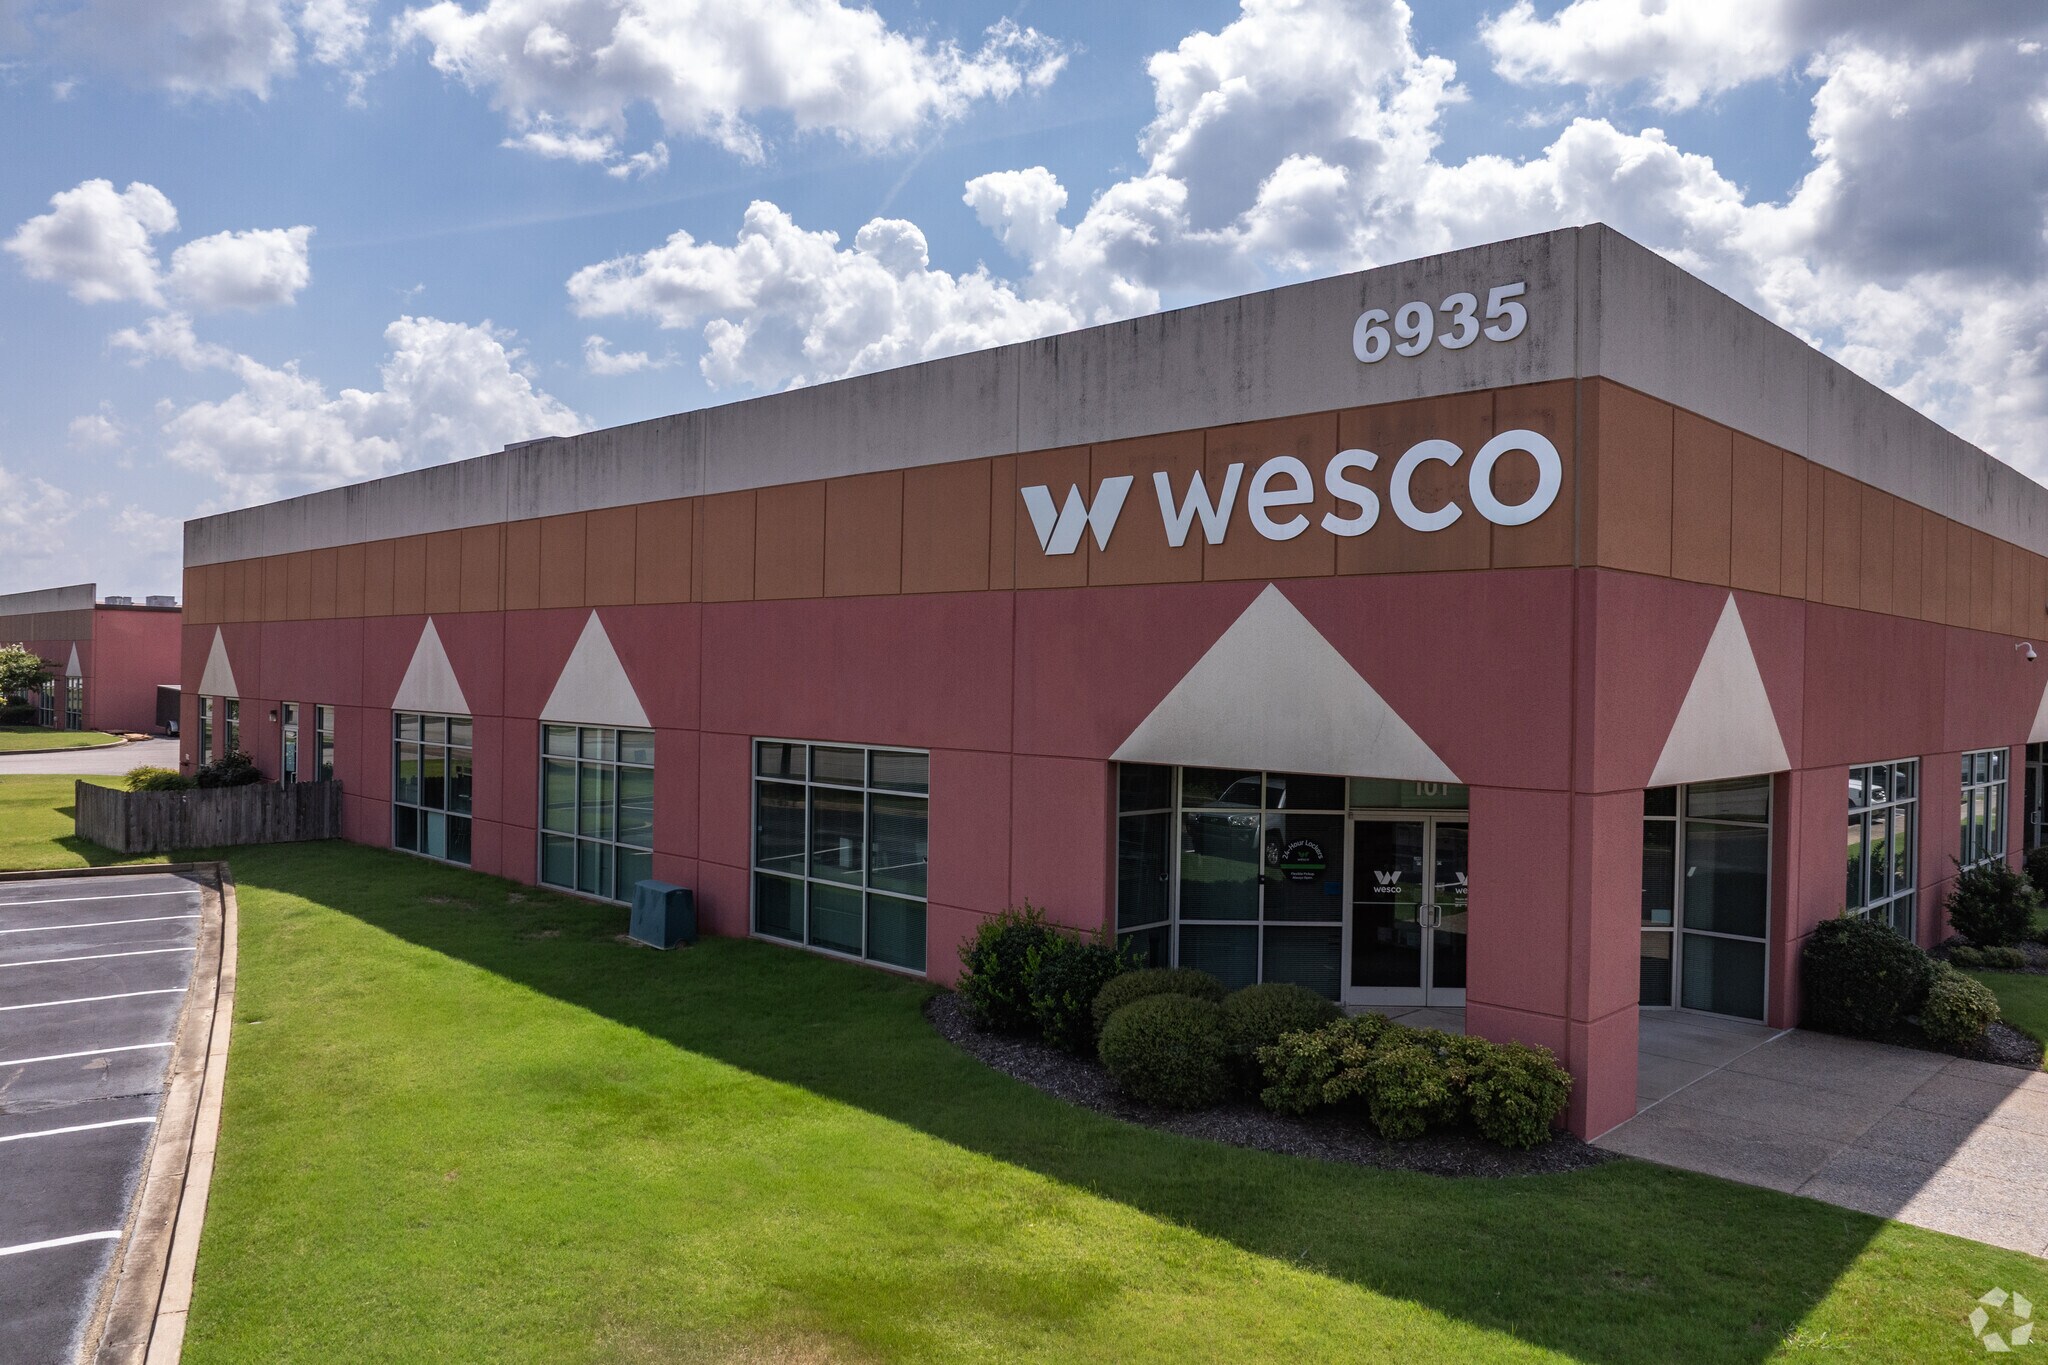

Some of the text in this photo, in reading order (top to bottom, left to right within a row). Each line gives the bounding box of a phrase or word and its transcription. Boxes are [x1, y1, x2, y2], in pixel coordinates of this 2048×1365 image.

[1352, 281, 1528, 364] 6935
[1153, 429, 1562, 548] wesco
[1282, 840, 1324, 859] 24-Hour Lockers
[1373, 886, 1402, 894] wesco
